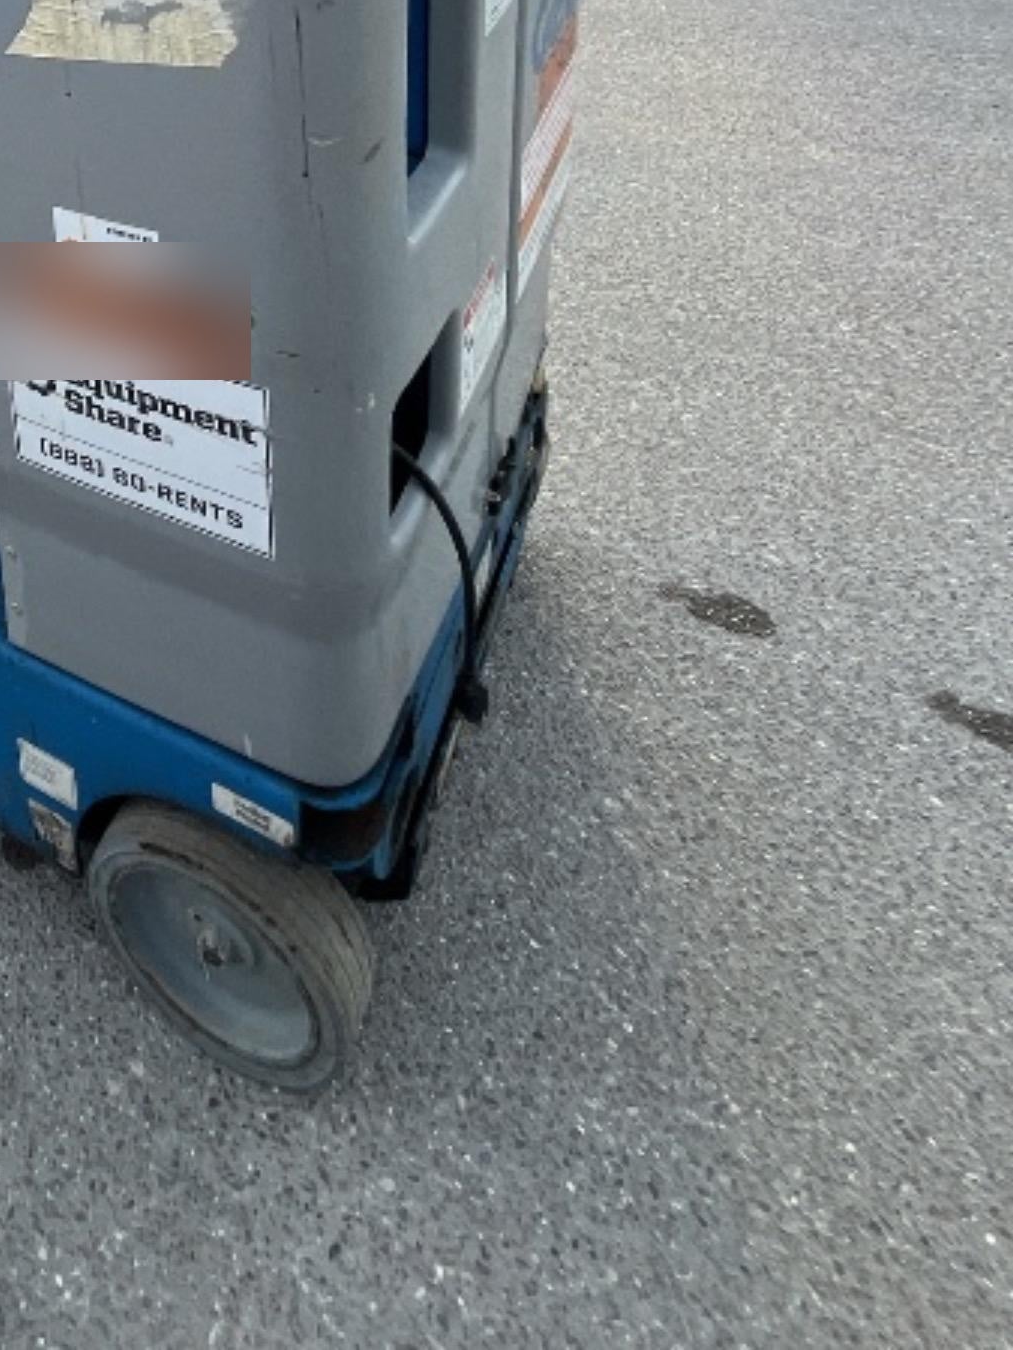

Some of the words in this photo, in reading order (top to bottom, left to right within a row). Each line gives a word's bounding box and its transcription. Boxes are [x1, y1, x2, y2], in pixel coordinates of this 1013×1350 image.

[64, 388, 163, 443] Share
[65, 379, 259, 447] quipment
[41, 436, 105, 478] (888)
